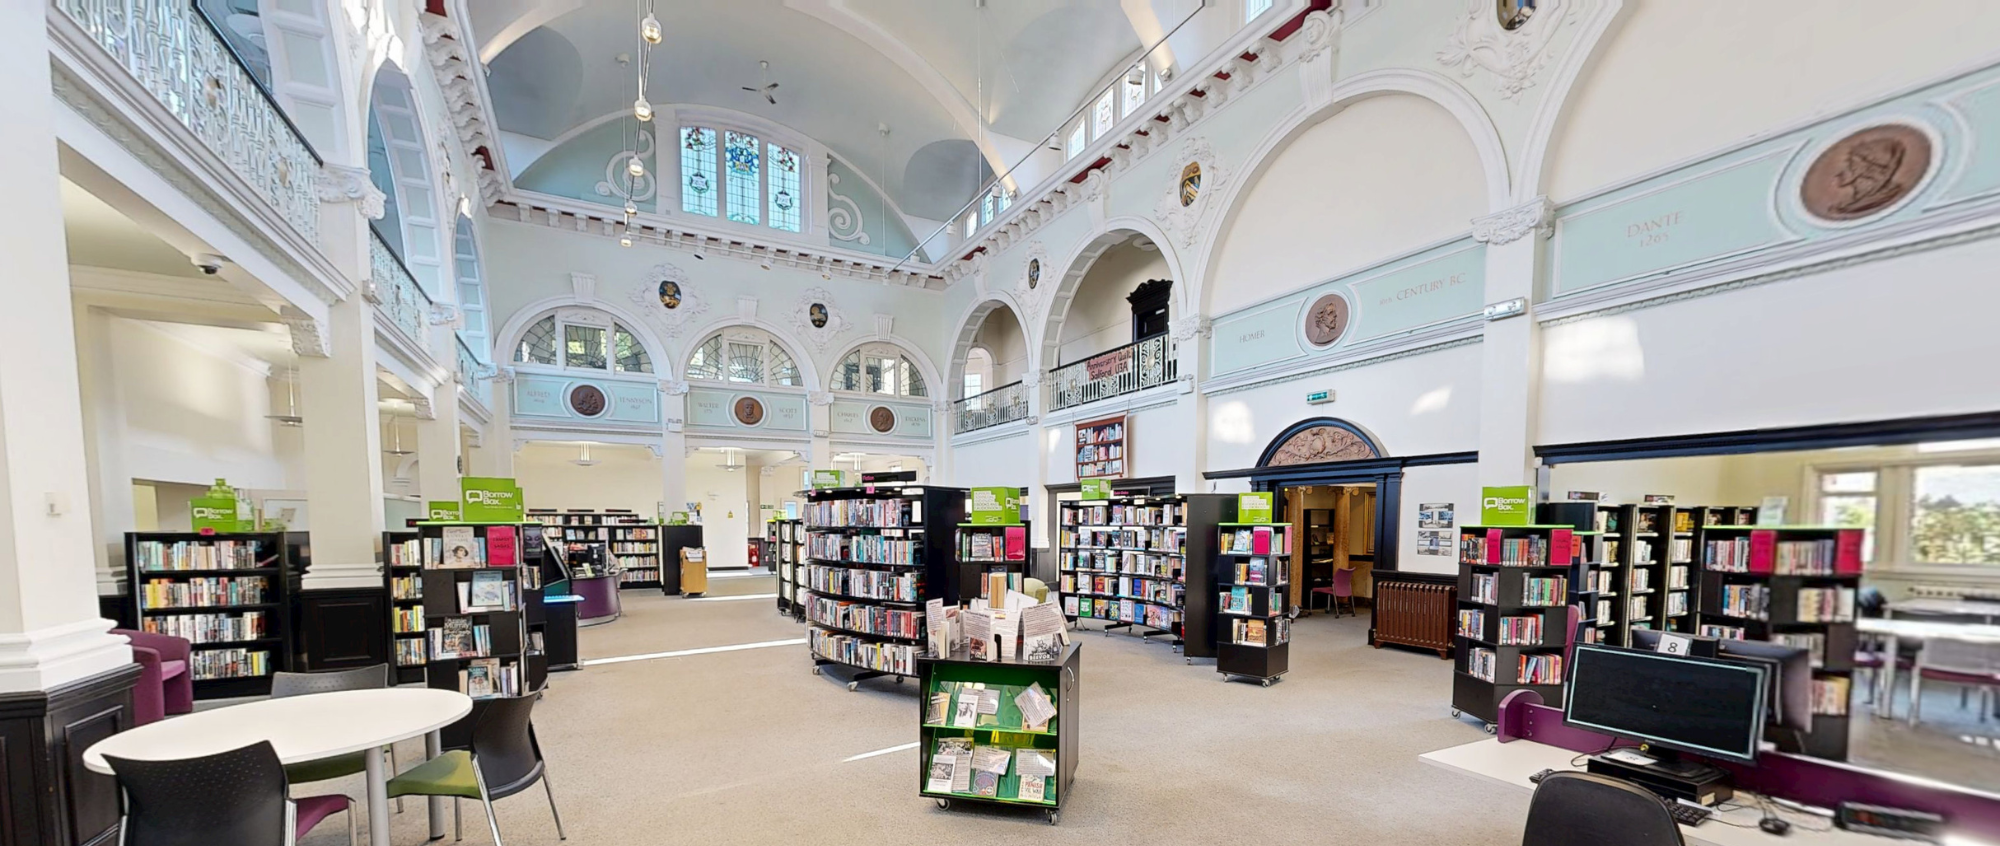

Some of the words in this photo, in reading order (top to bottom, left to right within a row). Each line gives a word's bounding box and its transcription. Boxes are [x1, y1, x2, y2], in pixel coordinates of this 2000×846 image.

[1627, 211, 1682, 238] DANTE
[1640, 231, 1669, 248] 1265
[1396, 278, 1446, 301] CENTURY
[1449, 272, 1467, 287] BC
[1239, 329, 1265, 343] HOMER
[1091, 367, 1112, 380] Salford
[619, 396, 652, 404] TENNYSON
[483, 490, 513, 498] Borrow
[1667, 641, 1678, 653] 8
